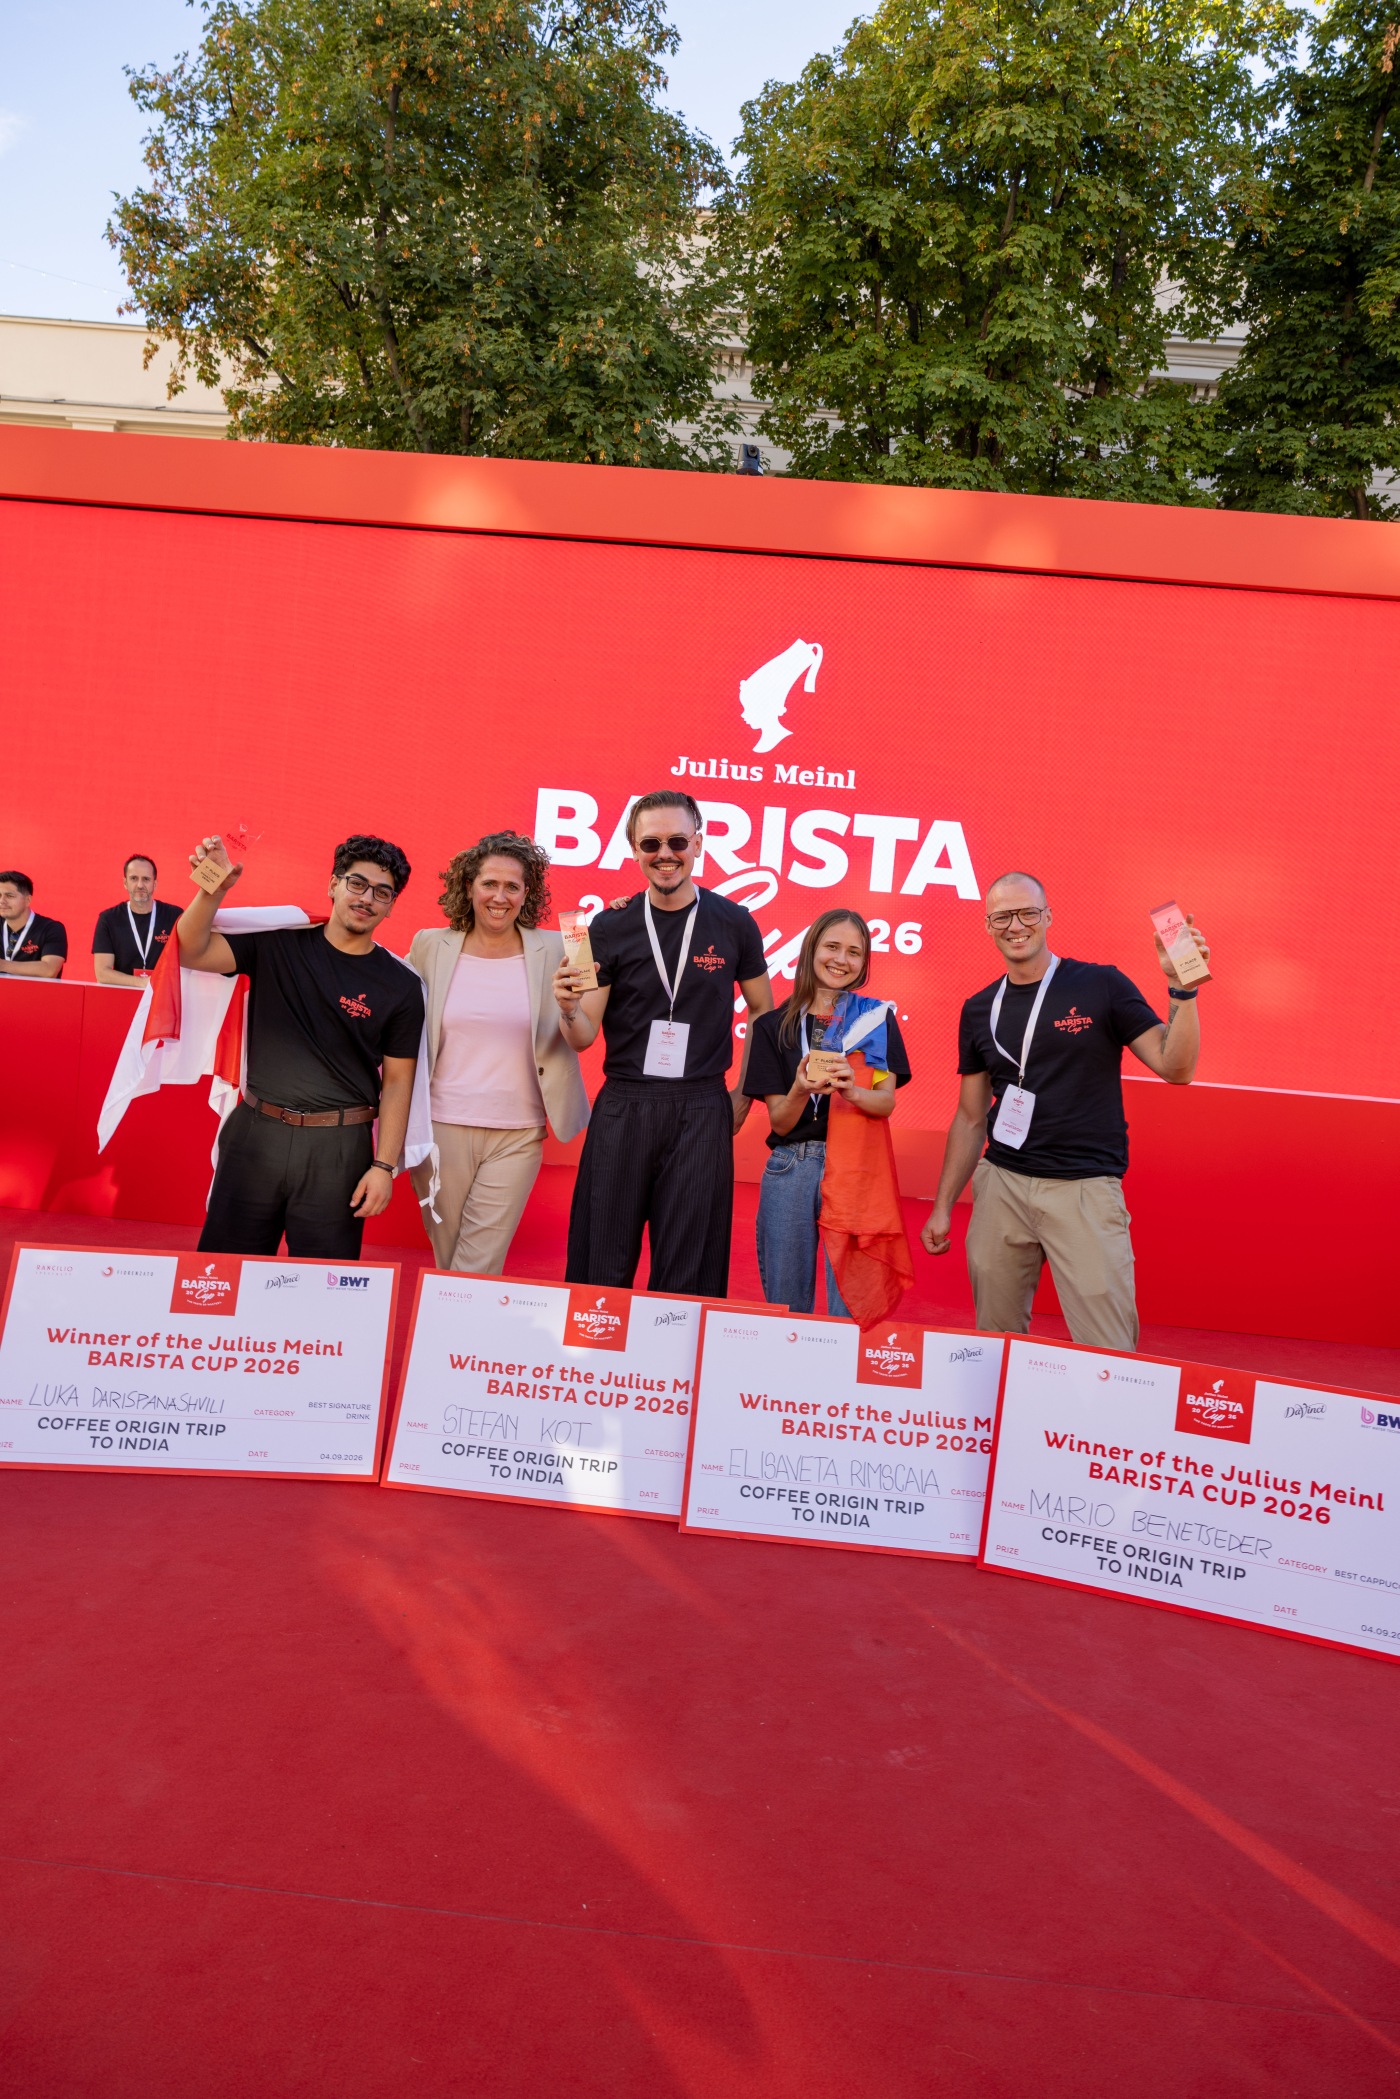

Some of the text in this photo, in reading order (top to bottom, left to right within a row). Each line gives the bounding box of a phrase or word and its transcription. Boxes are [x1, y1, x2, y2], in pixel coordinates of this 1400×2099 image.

[670, 755, 856, 790] Julius Meinl
[869, 919, 923, 955] 26
[693, 955, 726, 965] BARISTA
[339, 996, 371, 1017] BARISTA
[1053, 1016, 1093, 1028] BARISTA
[36, 1264, 73, 1272] RANCILIO
[181, 1279, 231, 1291] BARISTA
[265, 1273, 300, 1290] DaVinci
[339, 1276, 370, 1287] BWT
[195, 1288, 215, 1303] Cup
[438, 1290, 473, 1299] RANCILIO
[573, 1311, 621, 1325] BARISTA
[654, 1310, 688, 1327] DaVinci
[586, 1322, 606, 1337] Cup
[723, 1328, 759, 1336] RANCILIO
[46, 1327, 343, 1356] Winner of the Julius Meinl
[87, 1350, 300, 1375] BARISTA CUP 2026
[865, 1348, 915, 1362] BARISTA
[948, 1347, 984, 1363] DaVinci
[449, 1353, 527, 1377] Winner
[532, 1364, 555, 1379] of
[559, 1366, 595, 1384] the
[600, 1371, 666, 1392] Julius
[880, 1358, 900, 1374] Cup
[1028, 1359, 1067, 1371] RANCILIO
[1114, 1374, 1155, 1387] FIORENZATO
[0, 1398, 23, 1406] NAME
[28, 1383, 79, 1407] LUKA
[486, 1379, 689, 1416] BARISTA CUP 2026
[328, 1402, 372, 1411] SIGNATURE
[739, 1392, 821, 1415] Winner
[827, 1402, 850, 1419] of
[855, 1404, 892, 1423] the
[898, 1409, 967, 1430] Julius
[1186, 1394, 1244, 1414] BARISTA
[1284, 1403, 1327, 1419] DaVinci
[253, 1409, 295, 1417] CATEGORY
[1202, 1406, 1226, 1425] Cup
[37, 1416, 227, 1437] COFFEE ORIGIN TRIP
[406, 1421, 428, 1430] NAME
[442, 1404, 592, 1447] STEFAN KOT
[90, 1436, 169, 1451] TO INDIA
[781, 1418, 992, 1455] BARISTA CUP 2026
[0, 1441, 14, 1449] IZE
[248, 1450, 269, 1458] DATE
[319, 1453, 363, 1461] 04.09.2026
[441, 1442, 618, 1473] COFFEE ORIGIN TRIP
[644, 1448, 685, 1459] CATEGORY
[399, 1462, 420, 1471] PRIZE
[701, 1463, 724, 1472] NAME
[729, 1448, 839, 1486] ELISAVETA
[1044, 1430, 1384, 1512] Winner of the Julius Meinl
[489, 1464, 564, 1486] TO INDIA
[639, 1490, 659, 1499] DATE
[740, 1485, 925, 1515] COFFEE ORIGIN TRIP
[950, 1488, 986, 1498] CATEGOR
[1089, 1461, 1331, 1525] BARISTA CUP 2026
[697, 1507, 720, 1516] PRIZE
[1001, 1500, 1025, 1511] NAME
[791, 1507, 870, 1528] TO INDIA
[1030, 1489, 1272, 1558] MARIO BENETSEDER
[949, 1532, 971, 1540] DATE
[995, 1544, 1020, 1556] PRIZE
[1041, 1527, 1247, 1581] COFFEE ORIGIN TRIP
[1097, 1556, 1183, 1588] TO INDIA
[1278, 1557, 1328, 1574] CATEGORY
[1334, 1569, 1358, 1581] BEST
[1273, 1604, 1298, 1616] DATE
